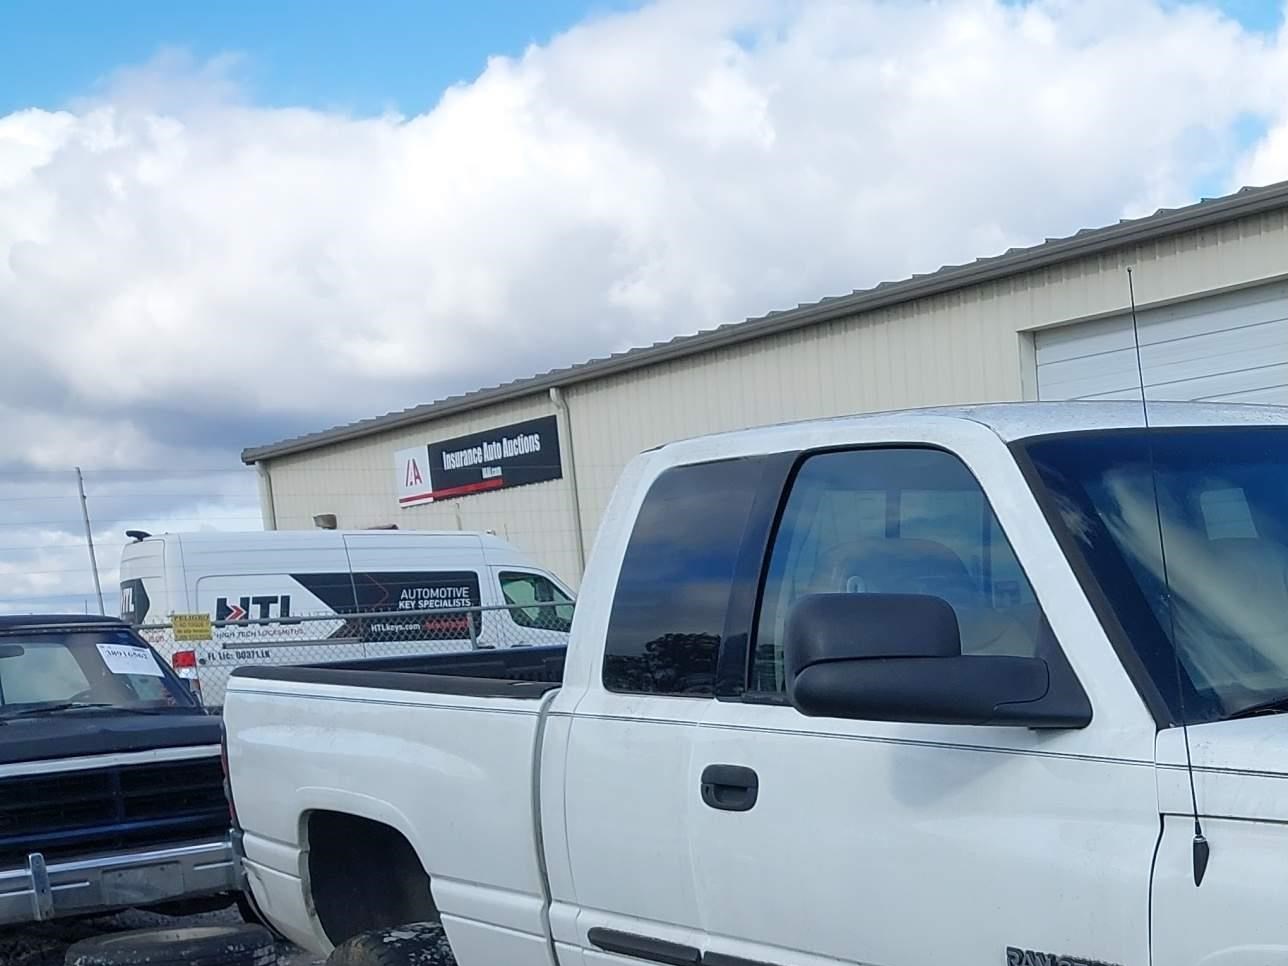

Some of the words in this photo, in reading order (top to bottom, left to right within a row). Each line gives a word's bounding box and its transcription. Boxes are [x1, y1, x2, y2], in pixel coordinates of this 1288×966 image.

[442, 446, 483, 471] Insurance
[483, 441, 502, 462] Auto
[502, 433, 540, 458] Auctions
[400, 587, 470, 600] AUTOMOTIVE
[398, 600, 416, 609] KEY
[418, 598, 472, 608] SPECIALISTS
